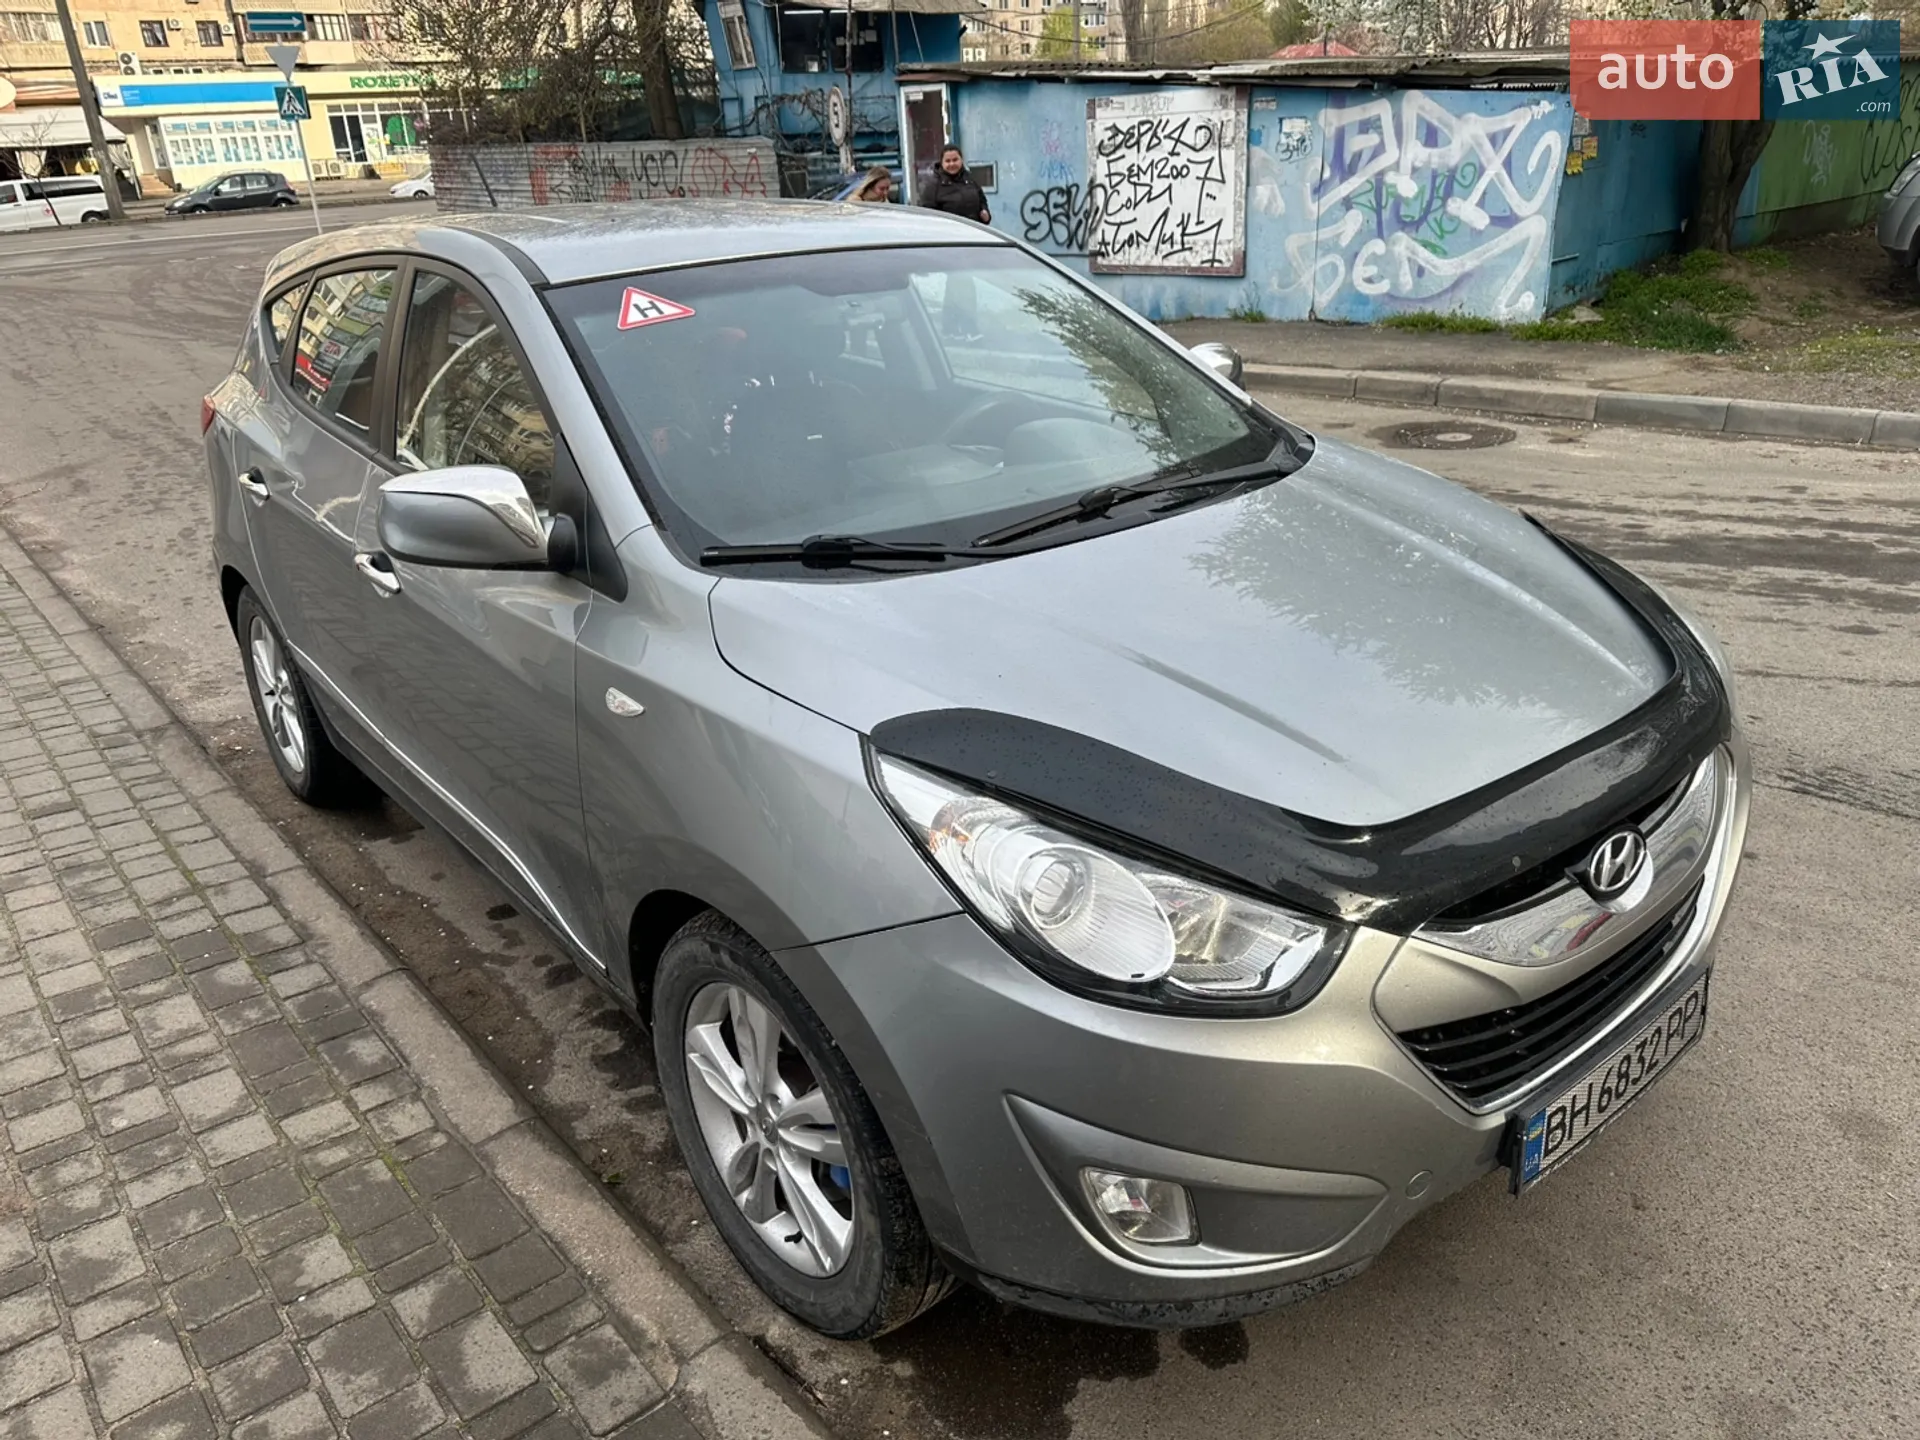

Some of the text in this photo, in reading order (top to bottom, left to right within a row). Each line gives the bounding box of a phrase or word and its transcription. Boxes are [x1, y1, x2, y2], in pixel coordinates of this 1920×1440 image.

[350, 74, 436, 88] ROZETK
[1543, 990, 1699, 1158] BH 6832 PP
